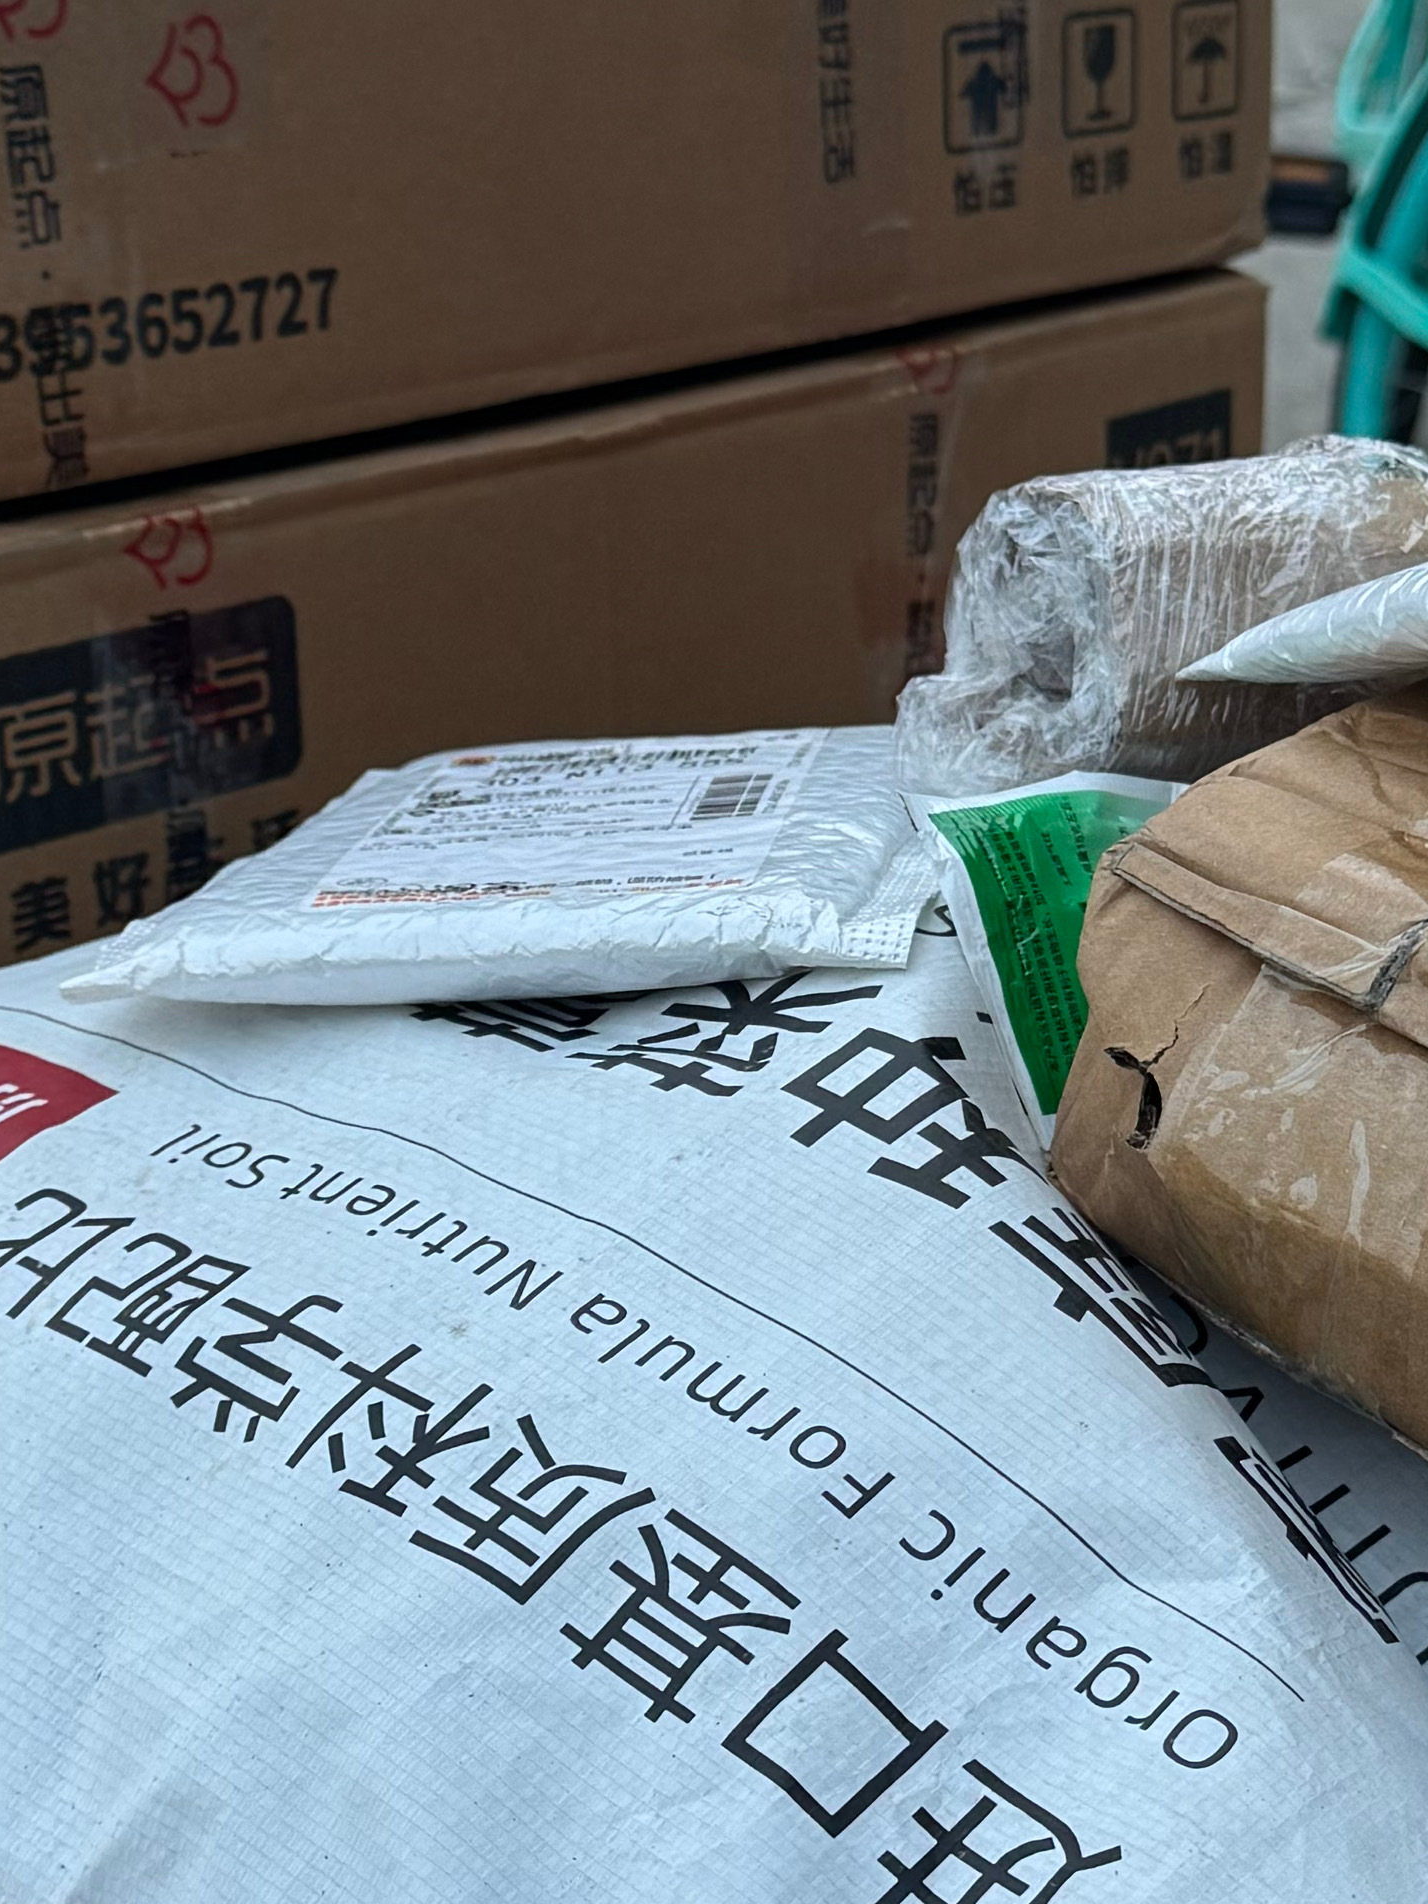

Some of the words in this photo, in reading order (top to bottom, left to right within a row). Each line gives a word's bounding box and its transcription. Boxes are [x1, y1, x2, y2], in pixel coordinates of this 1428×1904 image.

[149, 1123, 291, 1189] Soil
[278, 1162, 565, 1311] Nutrient
[570, 1292, 896, 1519] Formula
[898, 1509, 1239, 1770] Organic
